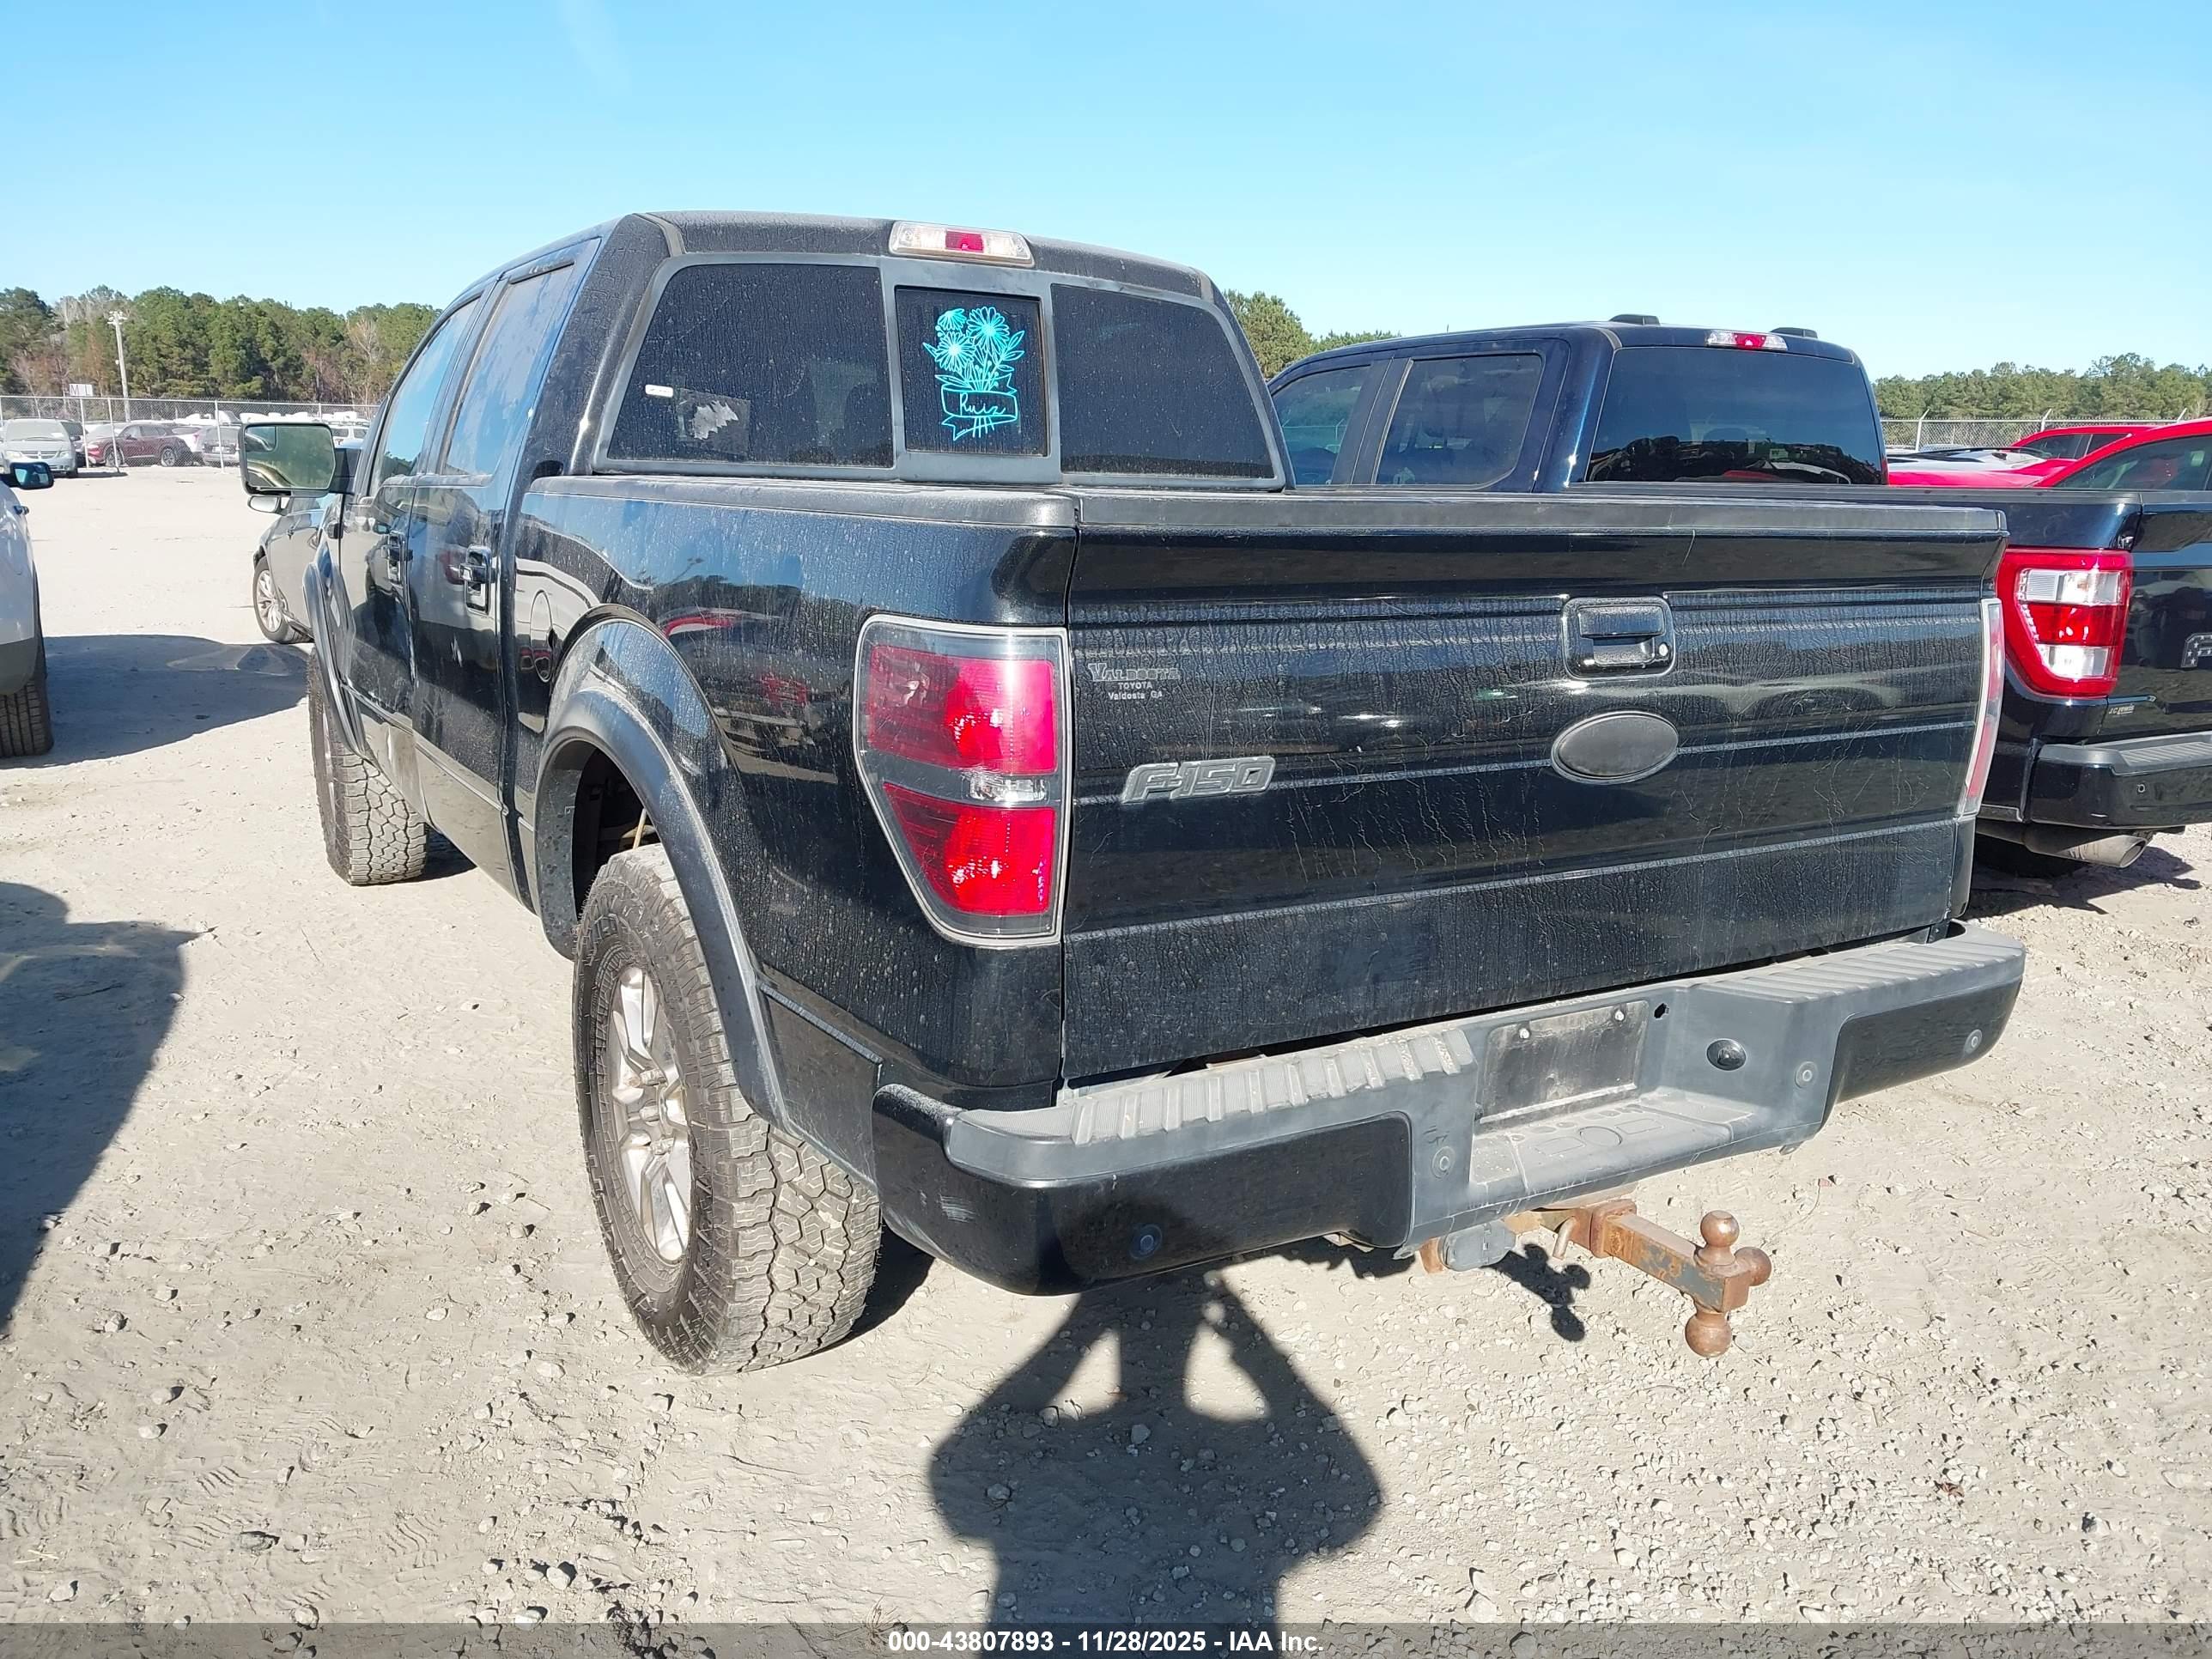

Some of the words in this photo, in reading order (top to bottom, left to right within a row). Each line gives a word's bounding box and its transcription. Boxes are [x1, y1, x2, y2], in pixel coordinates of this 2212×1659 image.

[959, 392, 1006, 416] Ruiz
[1117, 681, 1153, 690] TOYOTA
[1108, 691, 1146, 701] Valdosta
[1150, 690, 1164, 699] GA
[1121, 756, 1276, 805] F-150
